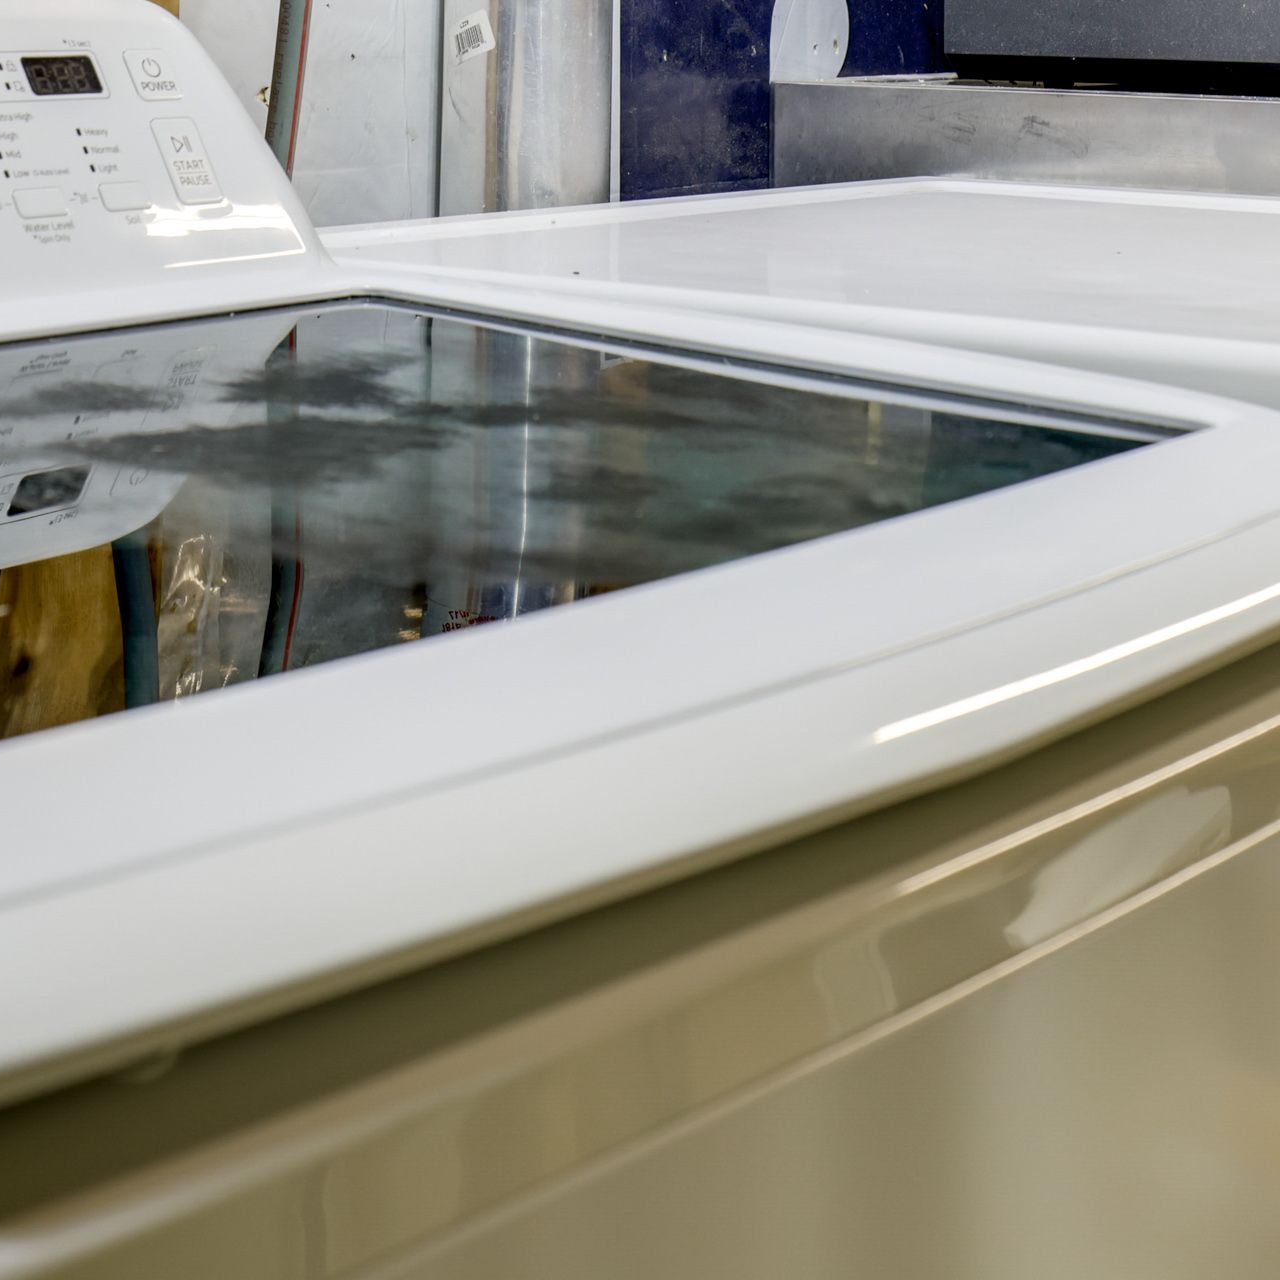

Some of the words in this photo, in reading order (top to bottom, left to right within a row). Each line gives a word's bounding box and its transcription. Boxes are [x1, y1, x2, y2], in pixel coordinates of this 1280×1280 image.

[140, 80, 177, 92] POWER
[173, 159, 205, 171] START
[178, 173, 213, 186] PAUSE
[23, 222, 49, 233] Water
